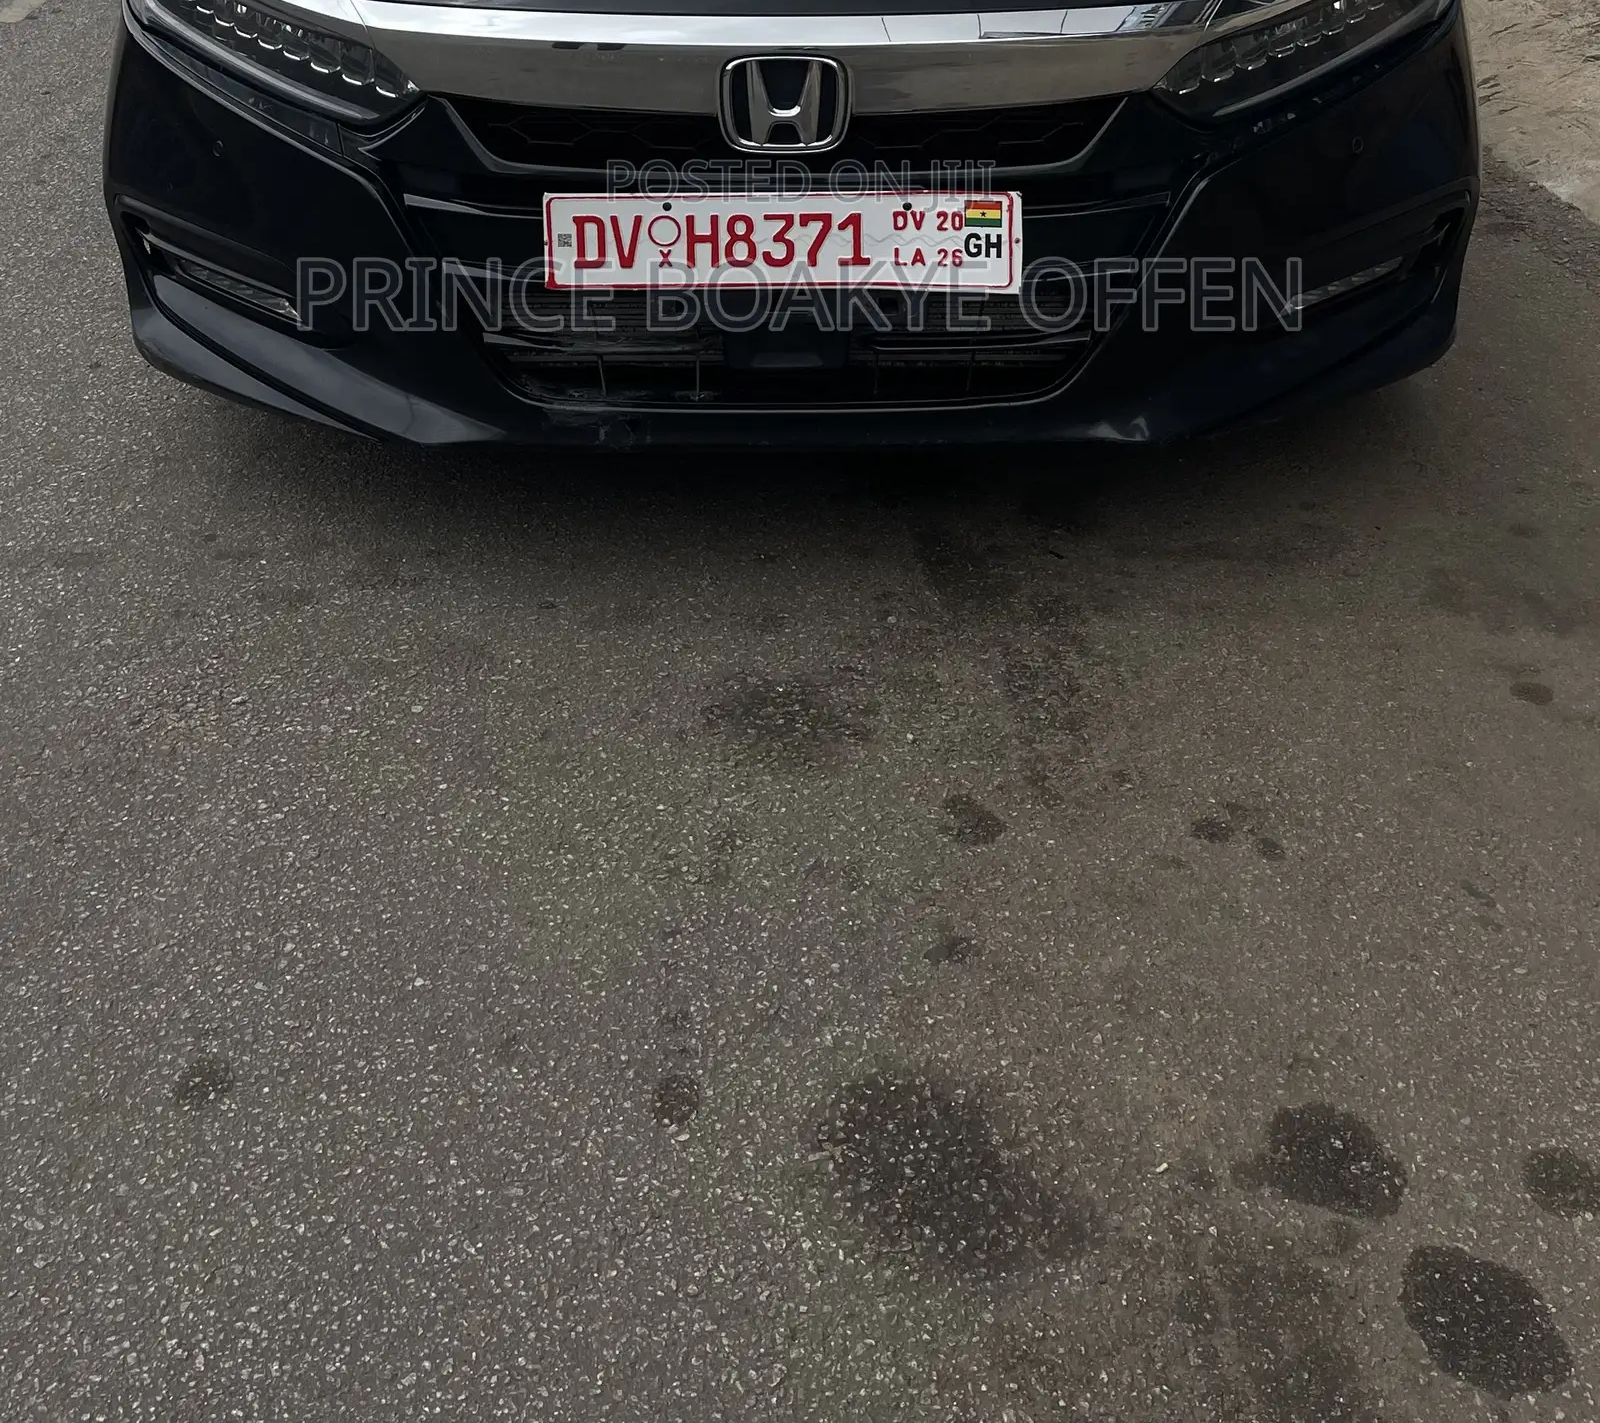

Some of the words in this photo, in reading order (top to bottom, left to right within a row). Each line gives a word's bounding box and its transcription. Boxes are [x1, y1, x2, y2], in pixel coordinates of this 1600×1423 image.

[892, 210, 926, 231] DV
[936, 211, 964, 232] 20
[572, 214, 643, 269] DV
[685, 212, 871, 269] H8371
[964, 232, 1002, 258] GH
[893, 247, 926, 266] LA
[937, 248, 964, 267] 26
